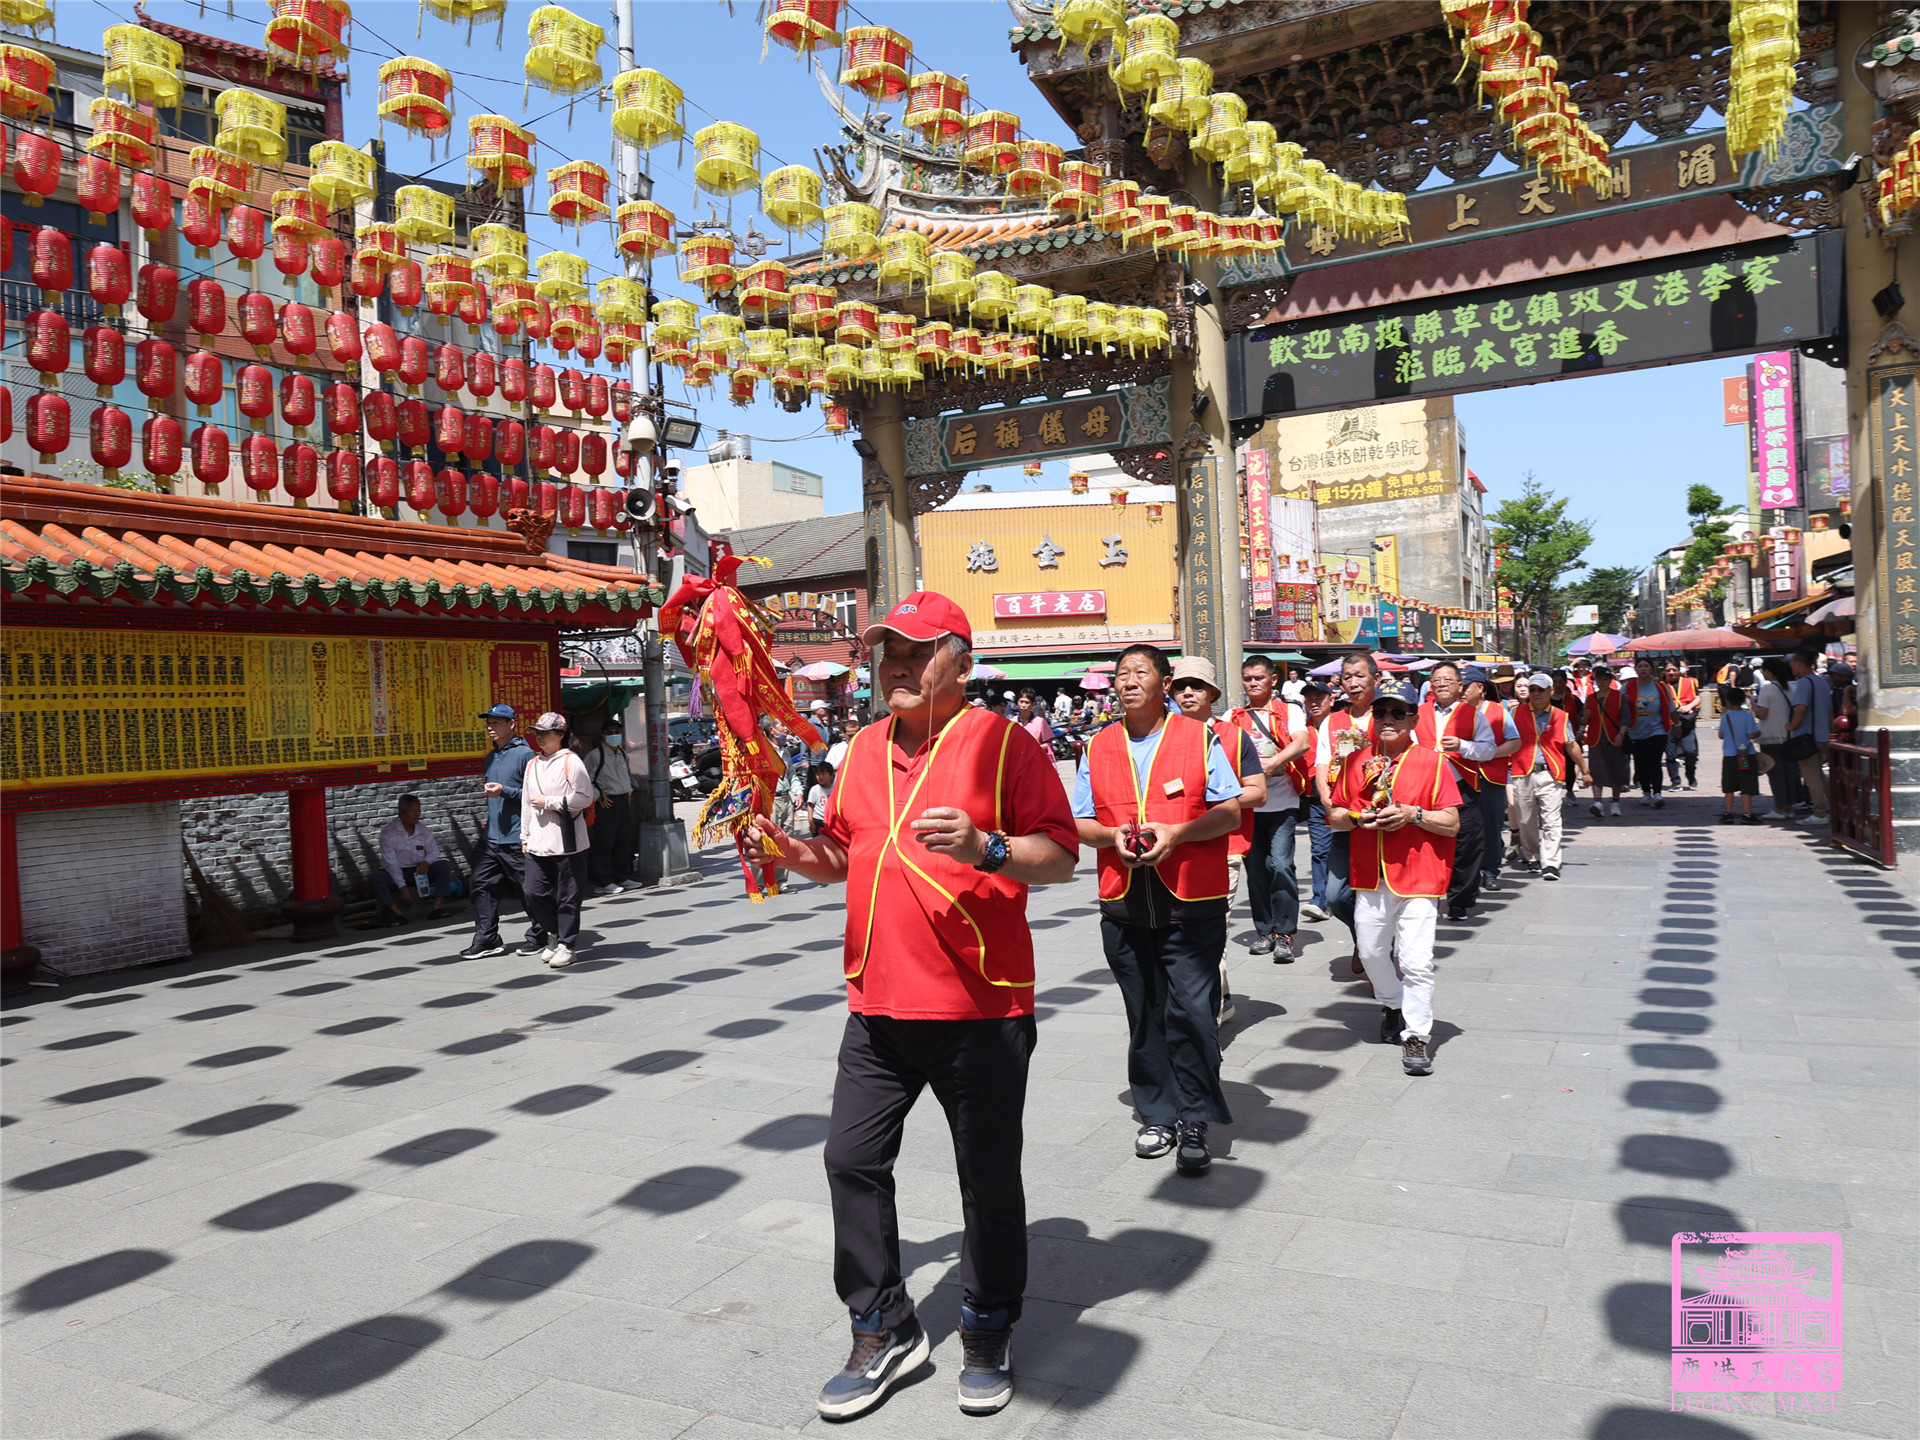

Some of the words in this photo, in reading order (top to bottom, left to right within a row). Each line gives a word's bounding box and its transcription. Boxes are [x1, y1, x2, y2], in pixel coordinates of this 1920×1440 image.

[1288, 439, 1421, 472] 台灣優格餅乾學院
[965, 532, 1179, 573] 施金玉
[1005, 592, 1096, 615] 百年老店
